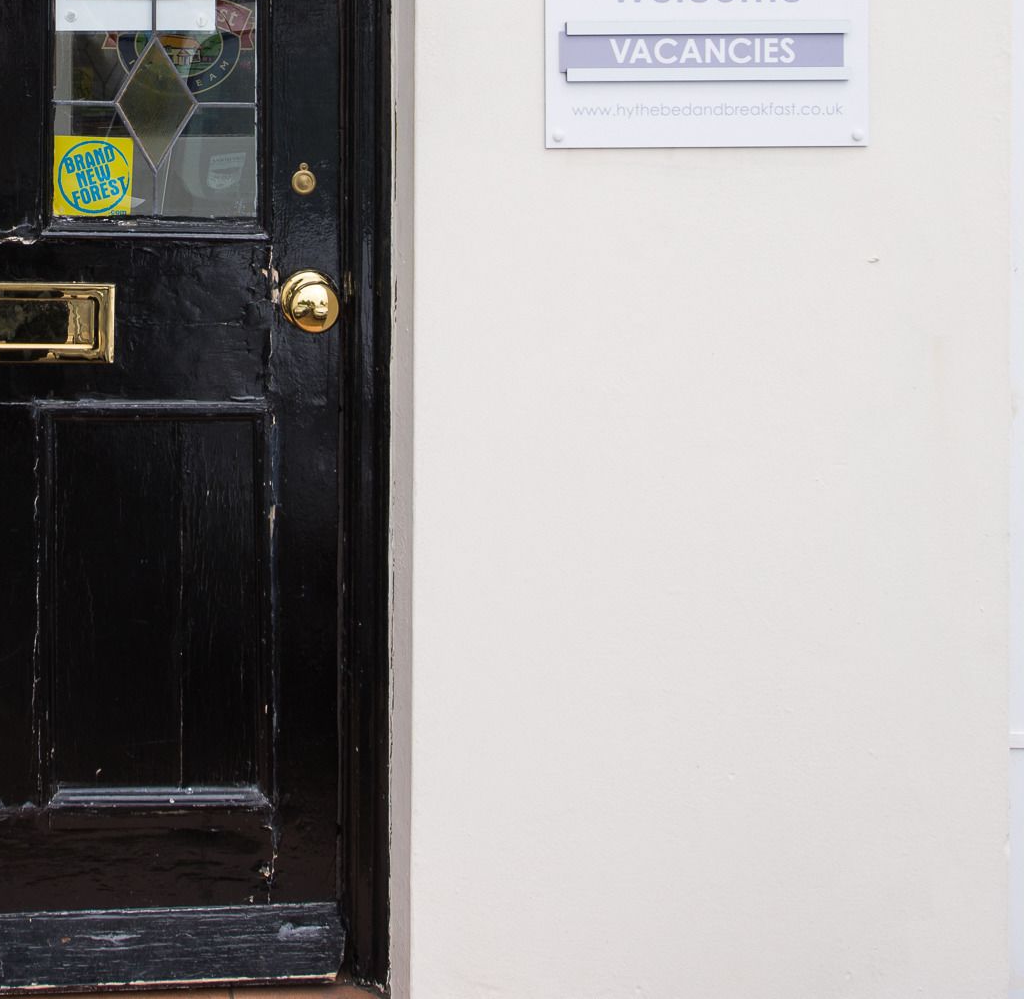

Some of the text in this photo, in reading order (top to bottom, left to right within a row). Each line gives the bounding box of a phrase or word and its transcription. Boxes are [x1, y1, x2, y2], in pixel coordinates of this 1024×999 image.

[609, 37, 796, 64] VACANCIES
[571, 102, 844, 121] www.hythebedandbreakfast.co.uk
[63, 144, 116, 174] BRAND
[75, 164, 111, 188] NEW
[71, 176, 127, 208] FOREST
